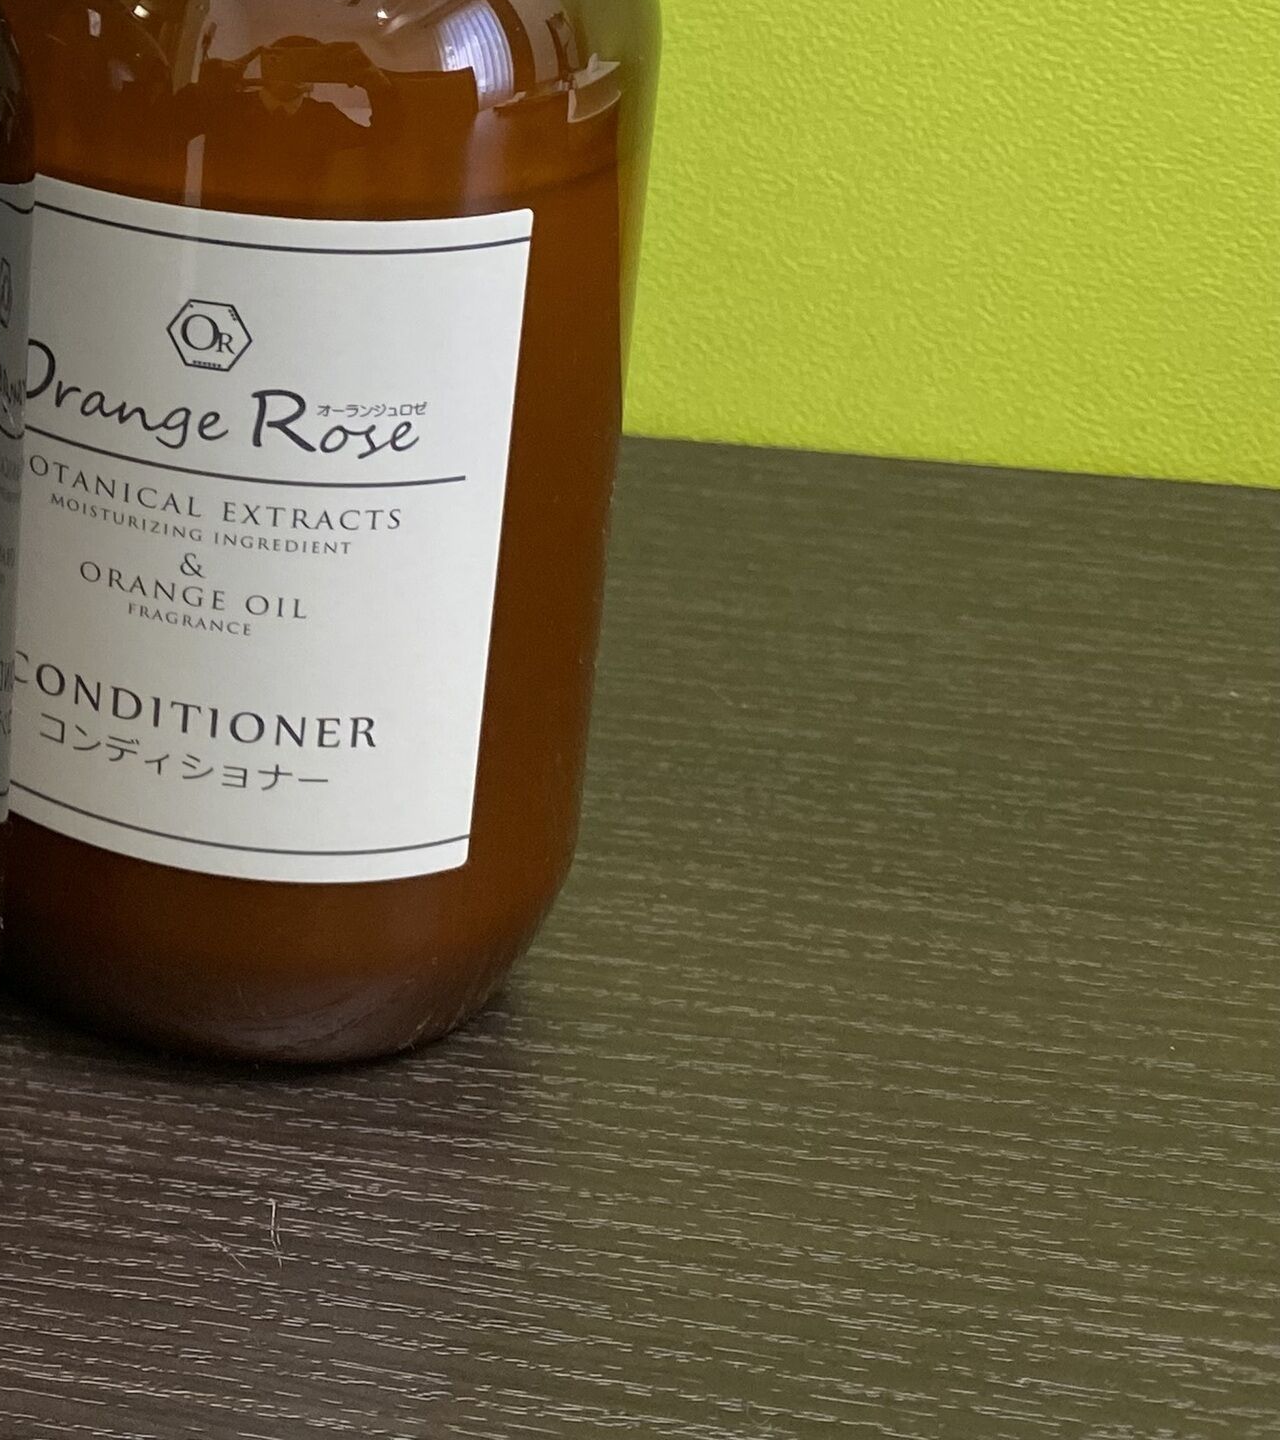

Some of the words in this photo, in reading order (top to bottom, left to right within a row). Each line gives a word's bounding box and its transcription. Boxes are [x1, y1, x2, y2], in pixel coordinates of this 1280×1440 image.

[251, 388, 419, 459] Rose
[316, 400, 427, 418] オーランジュロゼ
[29, 454, 202, 518] OTANICAL
[223, 501, 401, 531] EXTRACTS
[51, 493, 203, 542] MOISTURIZING
[214, 532, 352, 555] INGREDIENT
[80, 561, 226, 611] ORANGE
[245, 594, 307, 620] OIL
[180, 553, 206, 578] &
[127, 602, 252, 637] FRAGRANCE
[40, 713, 328, 791] コンディショナー
